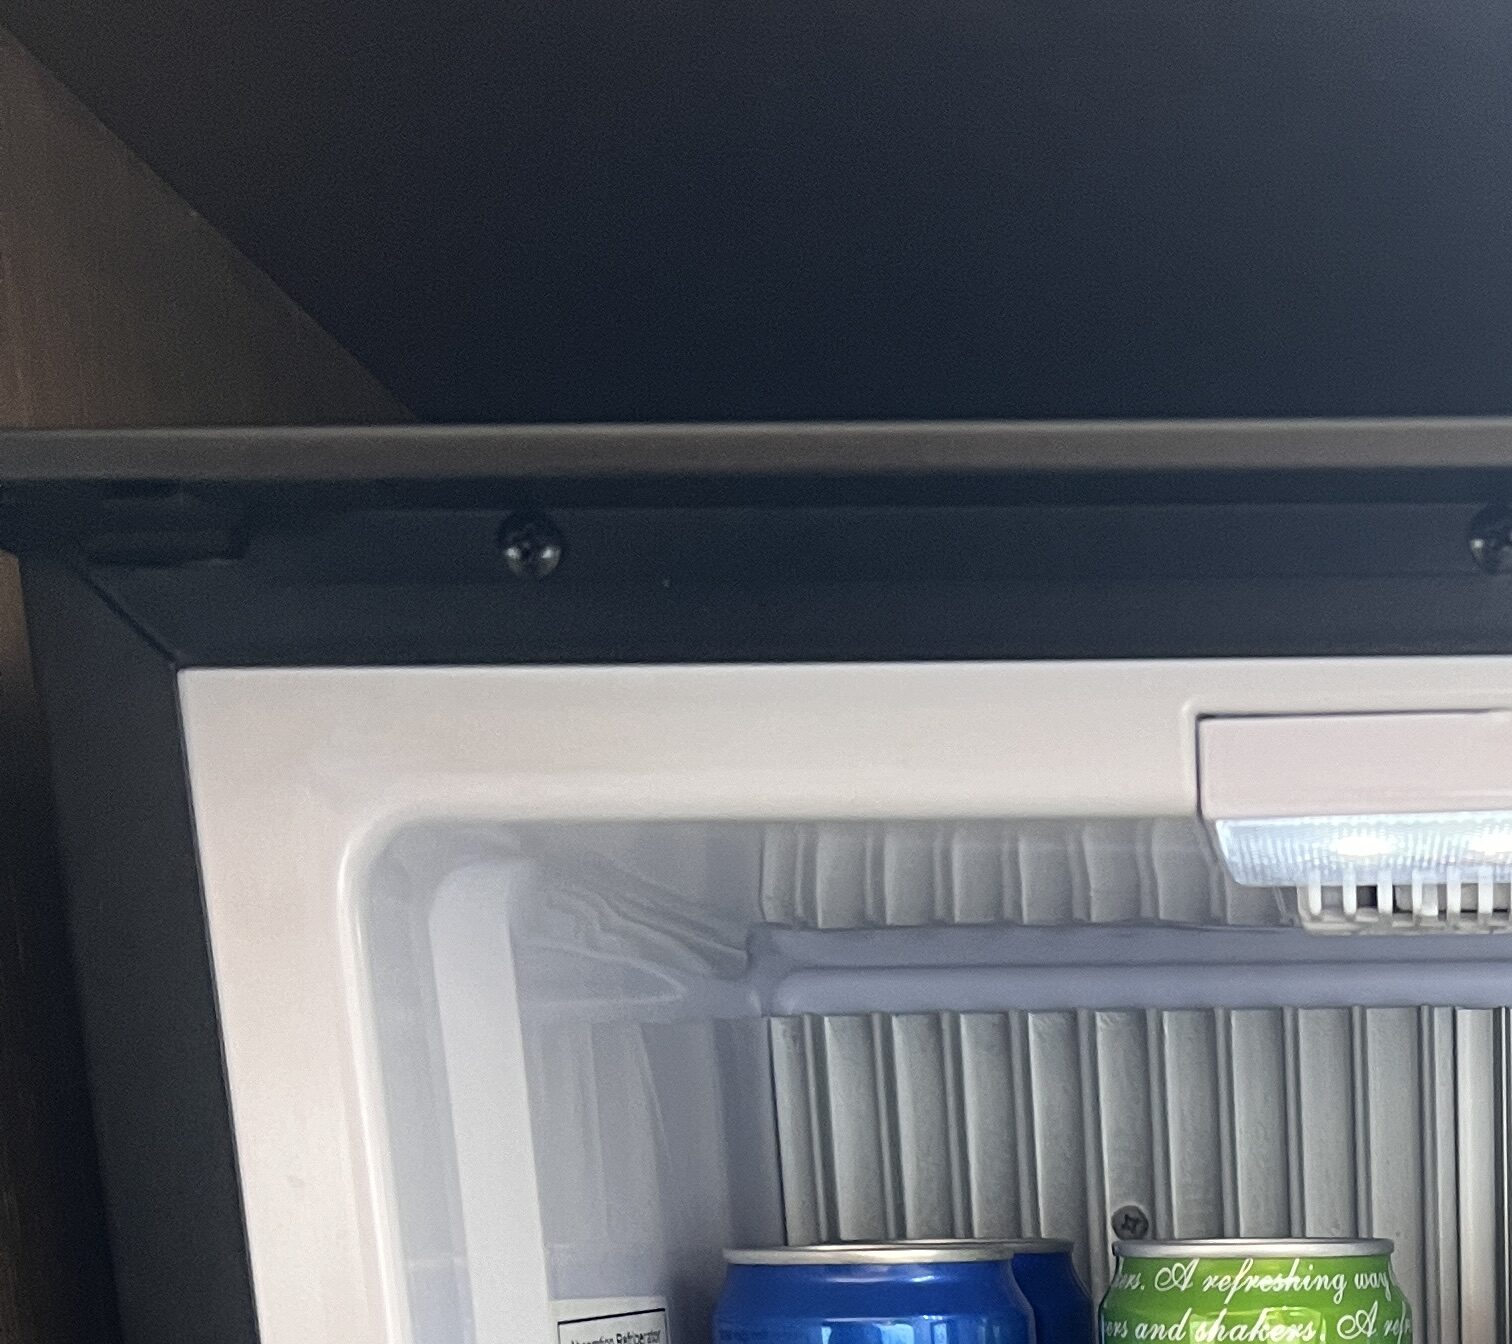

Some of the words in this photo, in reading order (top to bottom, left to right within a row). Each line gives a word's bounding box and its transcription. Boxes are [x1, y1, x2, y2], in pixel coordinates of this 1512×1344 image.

[1154, 1259, 1201, 1291] A
[1202, 1258, 1347, 1304] refreshing
[1354, 1270, 1392, 1301] way
[1135, 1308, 1191, 1342] and
[1337, 1301, 1377, 1340] A
